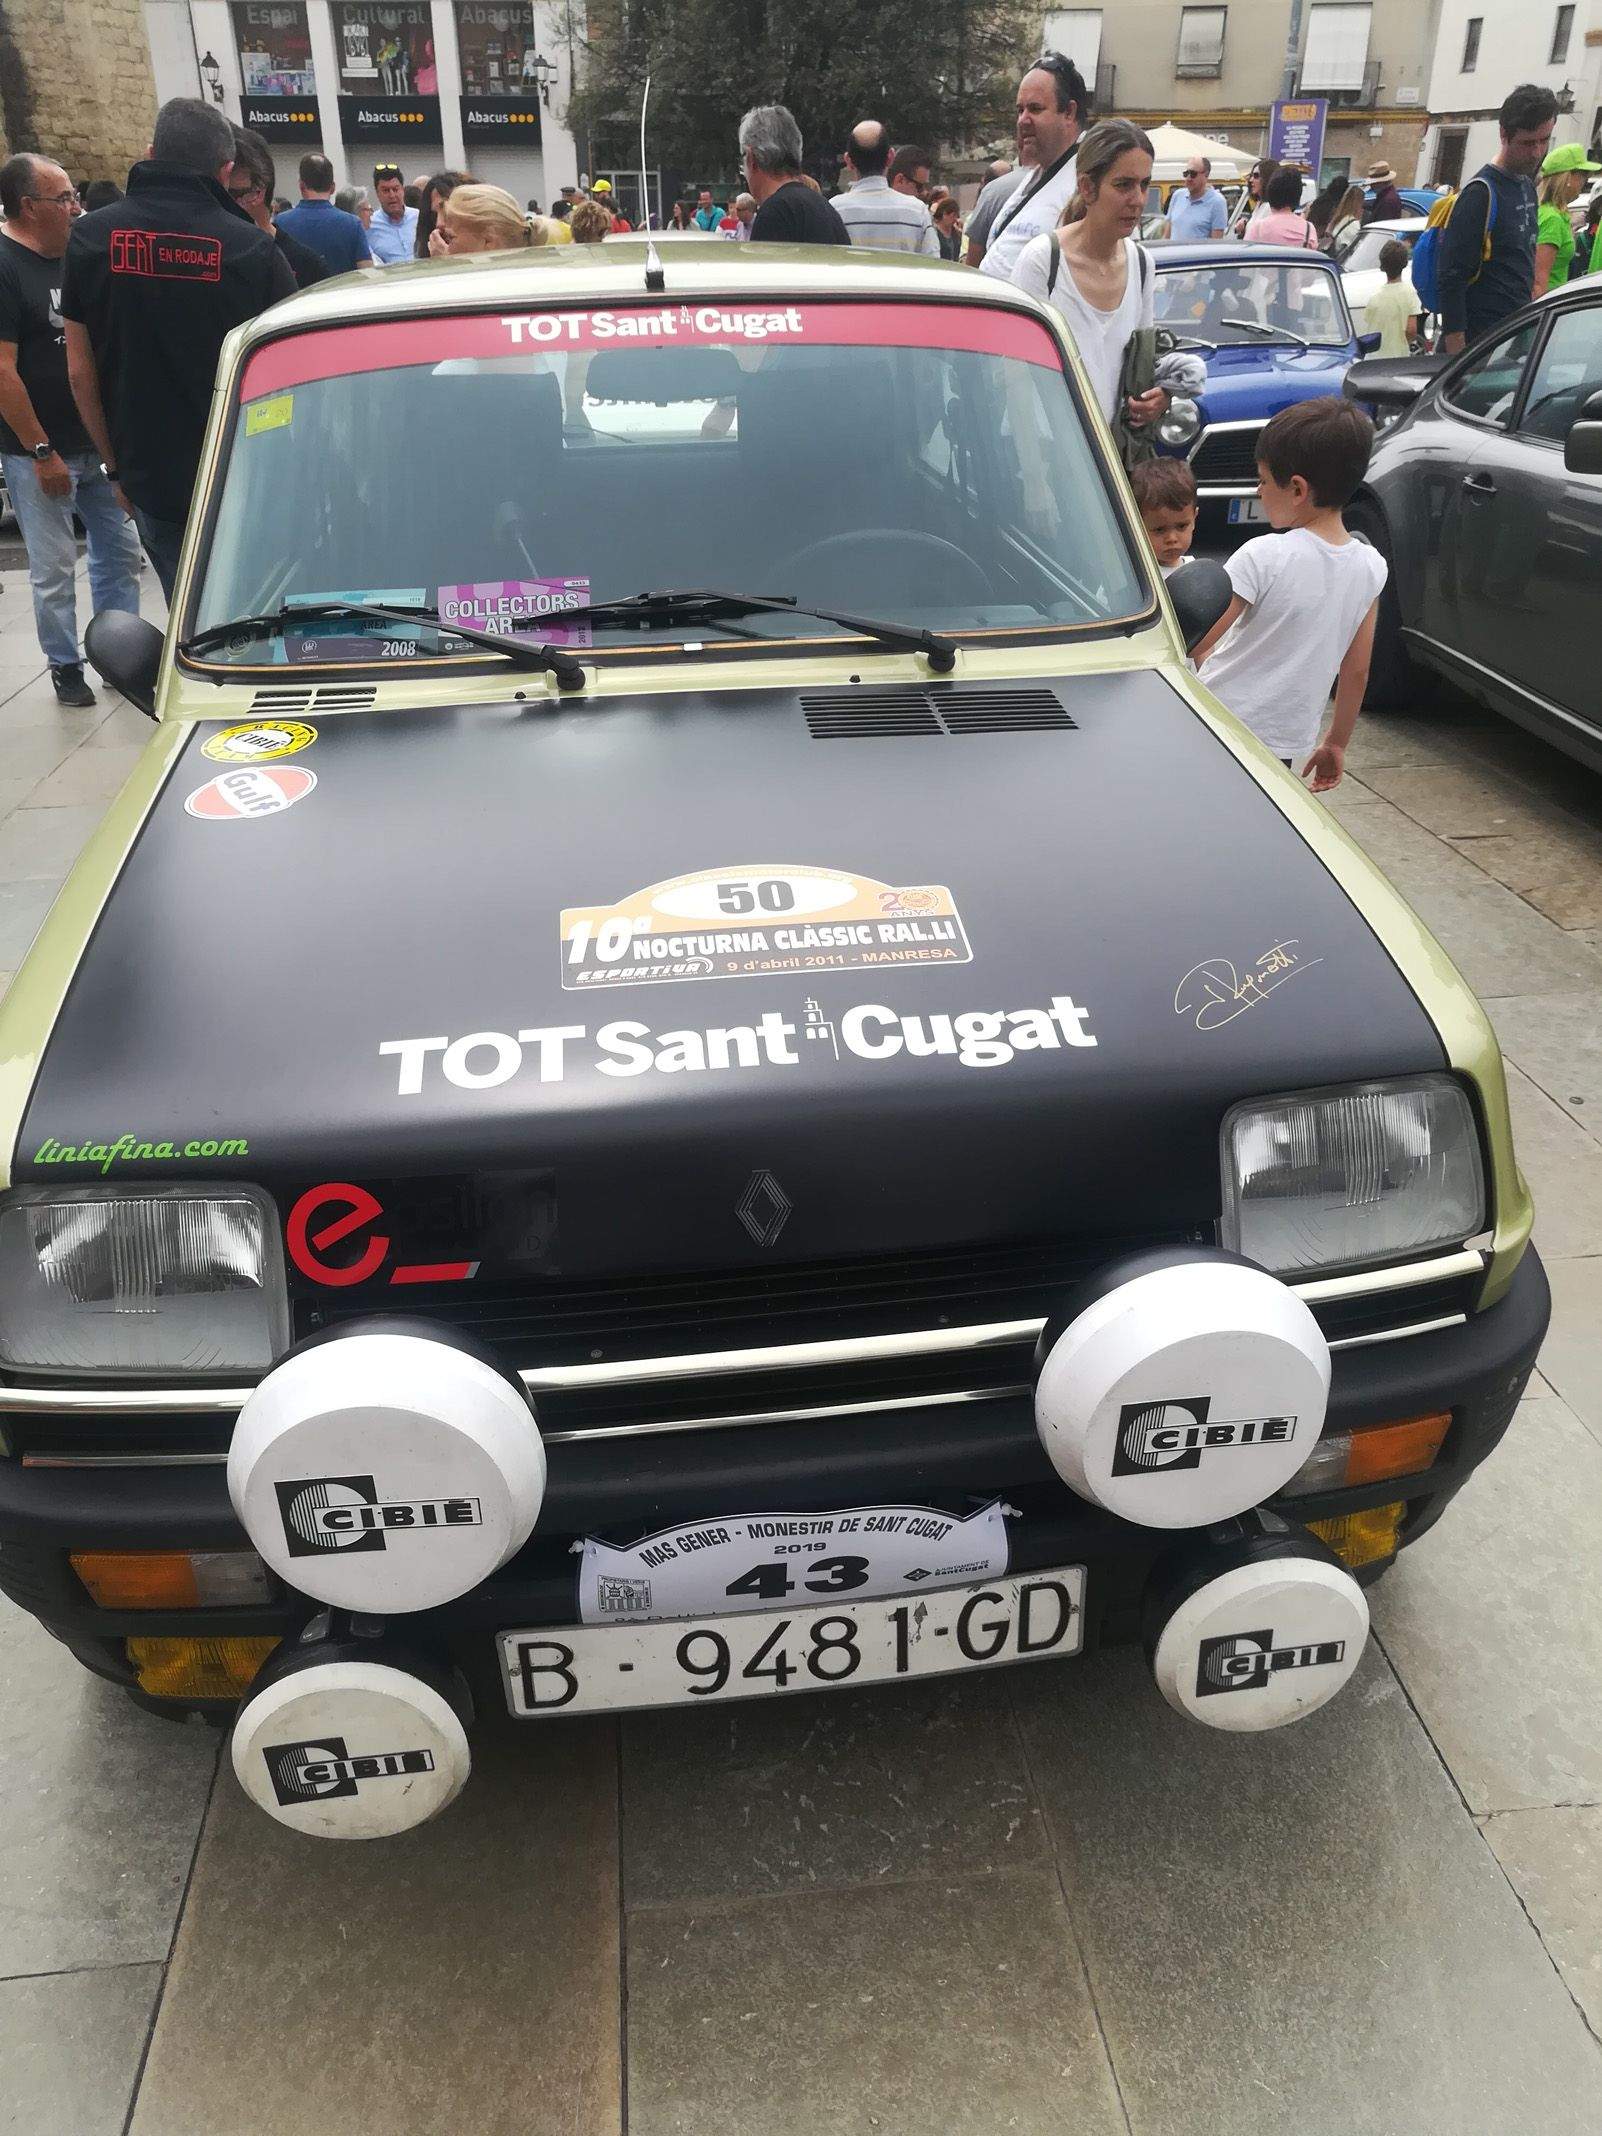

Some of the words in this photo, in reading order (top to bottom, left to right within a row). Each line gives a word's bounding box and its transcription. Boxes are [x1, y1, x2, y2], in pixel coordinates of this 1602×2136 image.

[343, 4, 426, 25] Cultural
[460, 4, 532, 25] Abacus
[249, 111, 289, 122] Abacus
[358, 111, 399, 123] Abacus
[468, 111, 509, 123] Abacus
[113, 234, 157, 274] SEAT
[159, 247, 173, 262] EN
[176, 250, 218, 266] RODAJE
[501, 313, 588, 343] TOT
[592, 310, 677, 338] Sant
[695, 307, 803, 338] Cugat
[445, 592, 579, 619] COLLECTORS
[381, 641, 416, 657] 2008
[223, 773, 281, 812] Gulf
[717, 880, 795, 914] 50
[632, 931, 769, 960] NOCTURNA
[774, 925, 874, 950] CLÀSSIC
[877, 920, 957, 943] RAL.LI
[727, 961, 738, 972] 9
[743, 954, 800, 970] d'abril
[805, 955, 845, 967] 2011
[862, 948, 957, 963] MANRESA
[379, 1025, 586, 1094] TOT
[594, 1013, 798, 1078] Sant
[841, 996, 1098, 1067] Cugat
[34, 1134, 249, 1175] liniafina.com
[639, 1542, 679, 1568] MAS
[677, 1527, 731, 1552] GENER
[747, 1520, 834, 1539] MONESTIR
[838, 1518, 859, 1533] DE
[863, 1516, 909, 1532] SANT
[905, 1517, 953, 1541] CUGAT
[774, 1542, 827, 1555] 2019
[725, 1555, 869, 1599] 43
